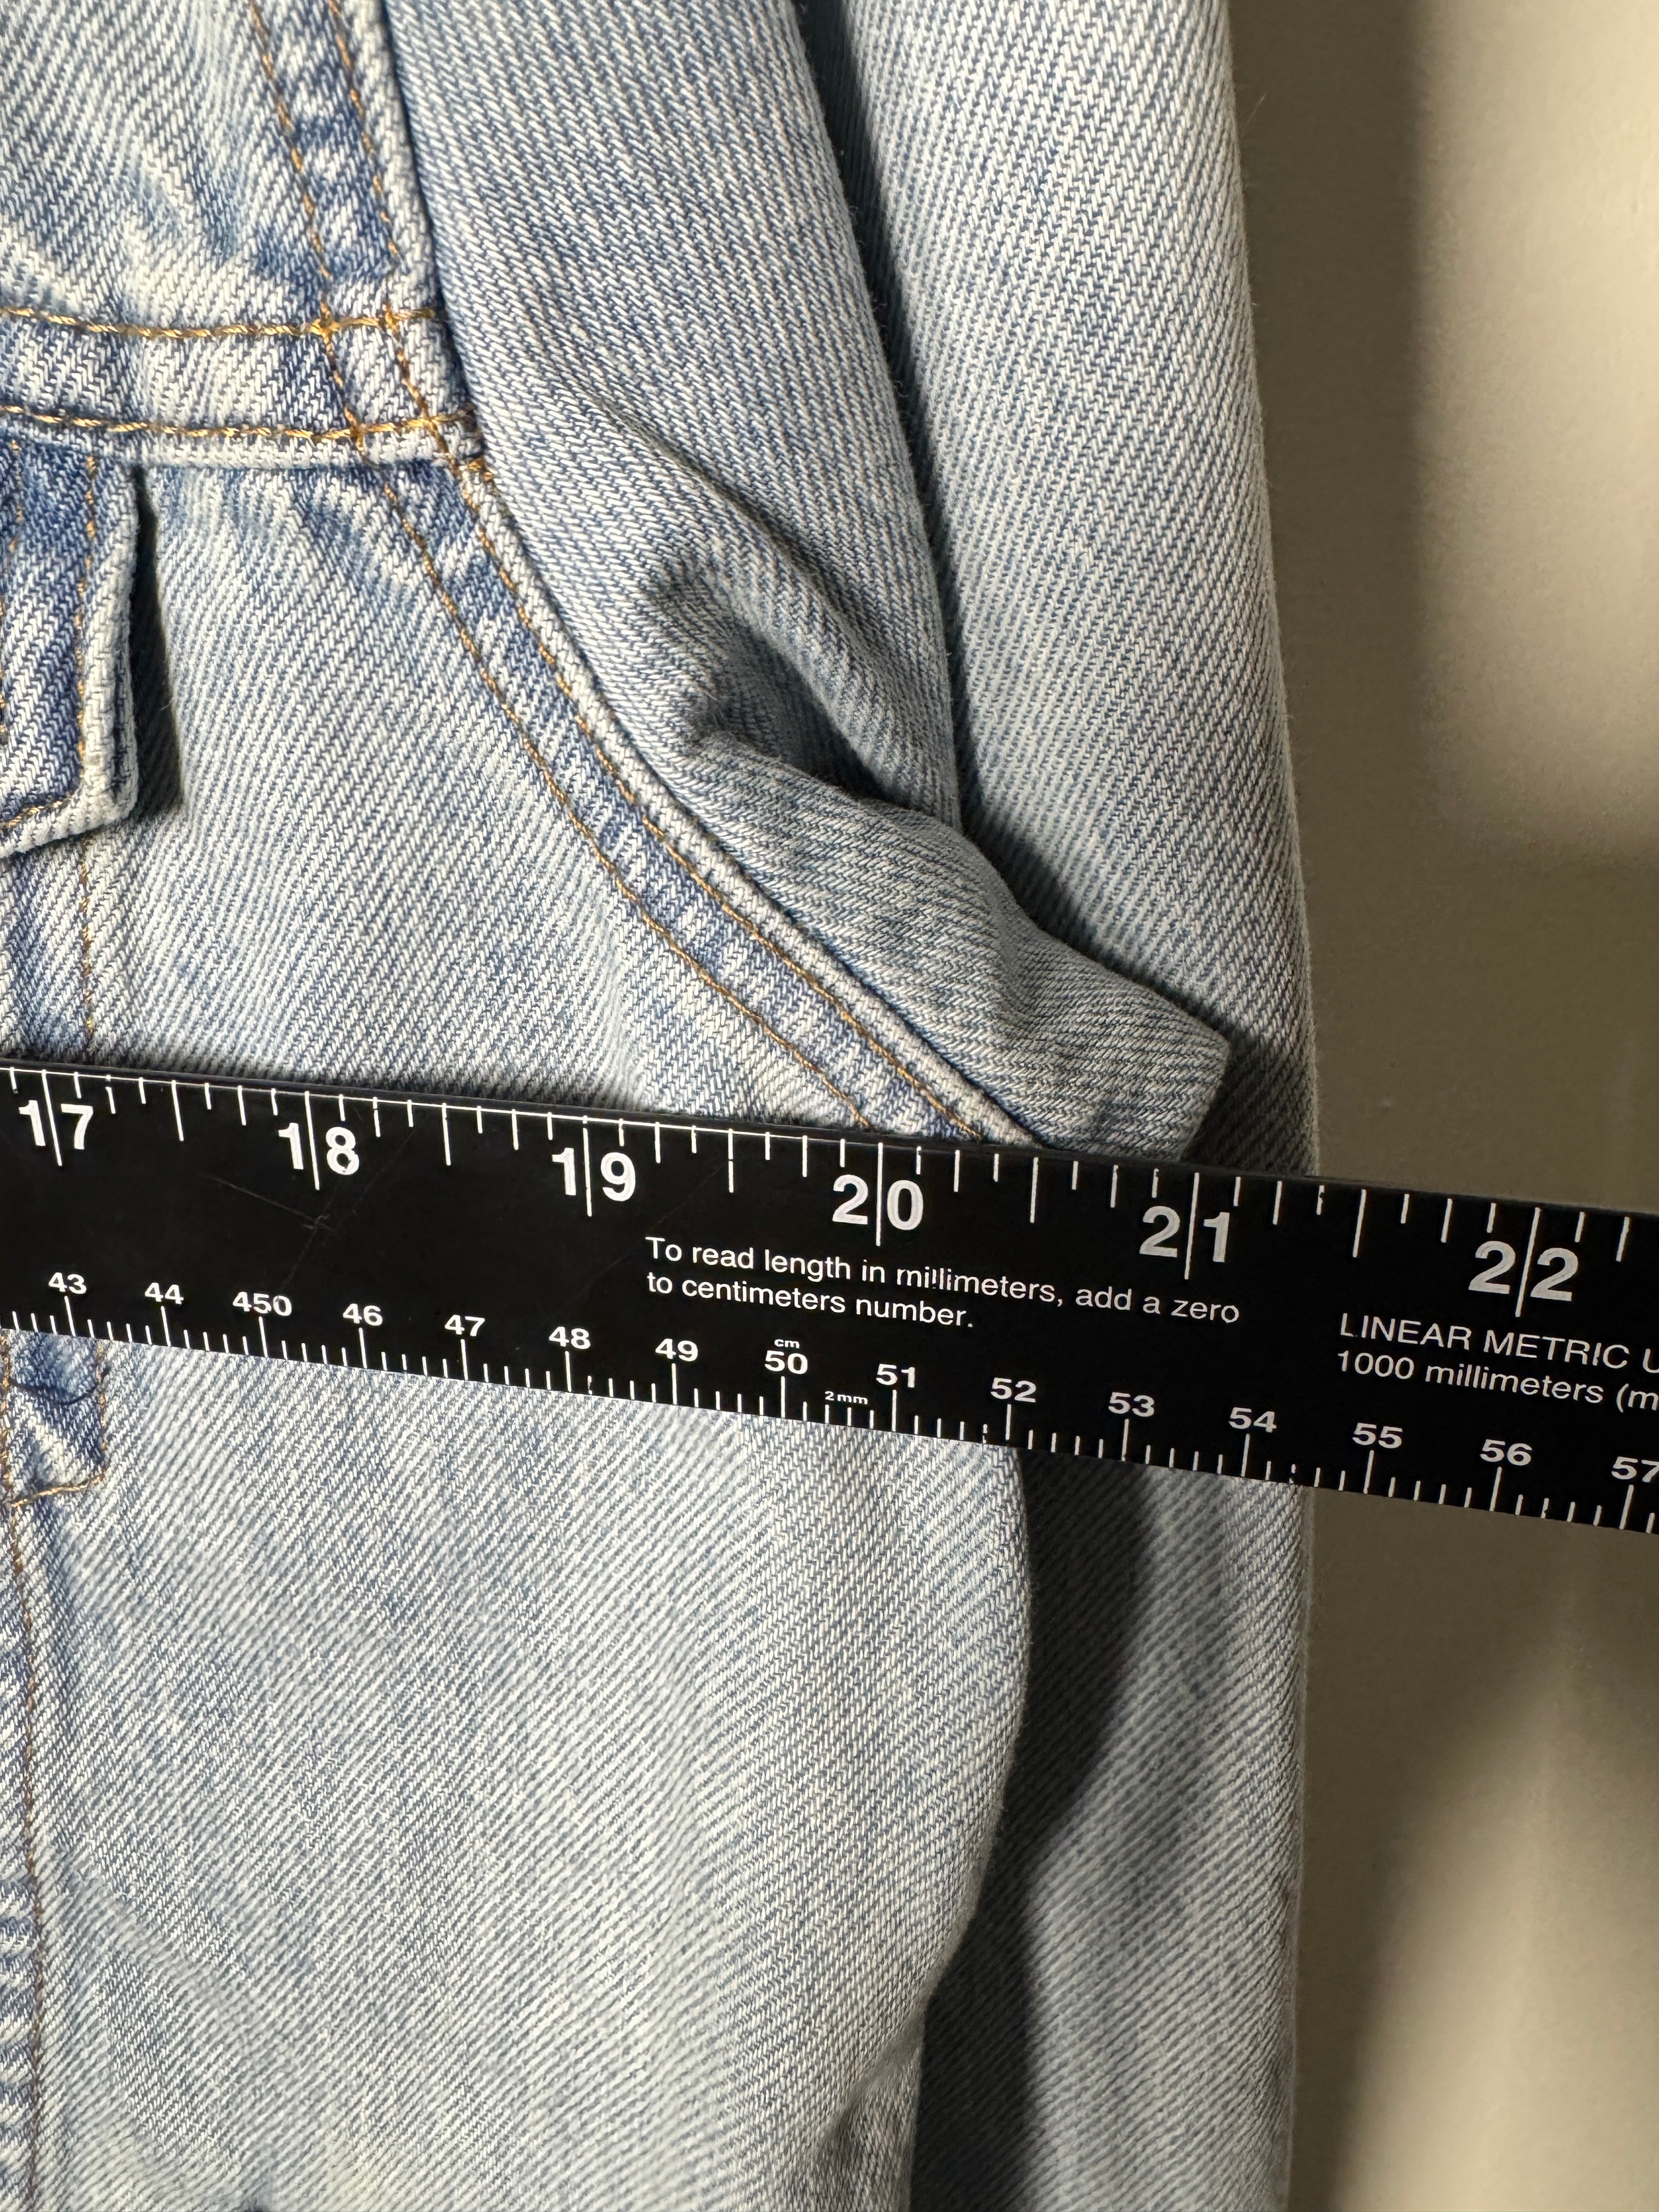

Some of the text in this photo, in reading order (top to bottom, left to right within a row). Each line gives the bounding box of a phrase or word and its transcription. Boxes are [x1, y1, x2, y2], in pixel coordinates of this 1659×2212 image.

[18, 1099, 1579, 1302] 17 18 19 20 21 22
[644, 1235, 1240, 1324] To read length in millimeters, add a zero
[646, 1271, 974, 1329] to centimeters number.
[774, 1338, 800, 1350] cm
[1339, 1312, 1472, 1351] LINEAR
[1483, 1329, 1630, 1369] METRIC
[47, 1271, 1659, 1483] 43 44 450 46 47 48 49 50 51 52 53 54 55 56 57
[1337, 1350, 1415, 1380] 1000
[1425, 1364, 1604, 1404] millimeters
